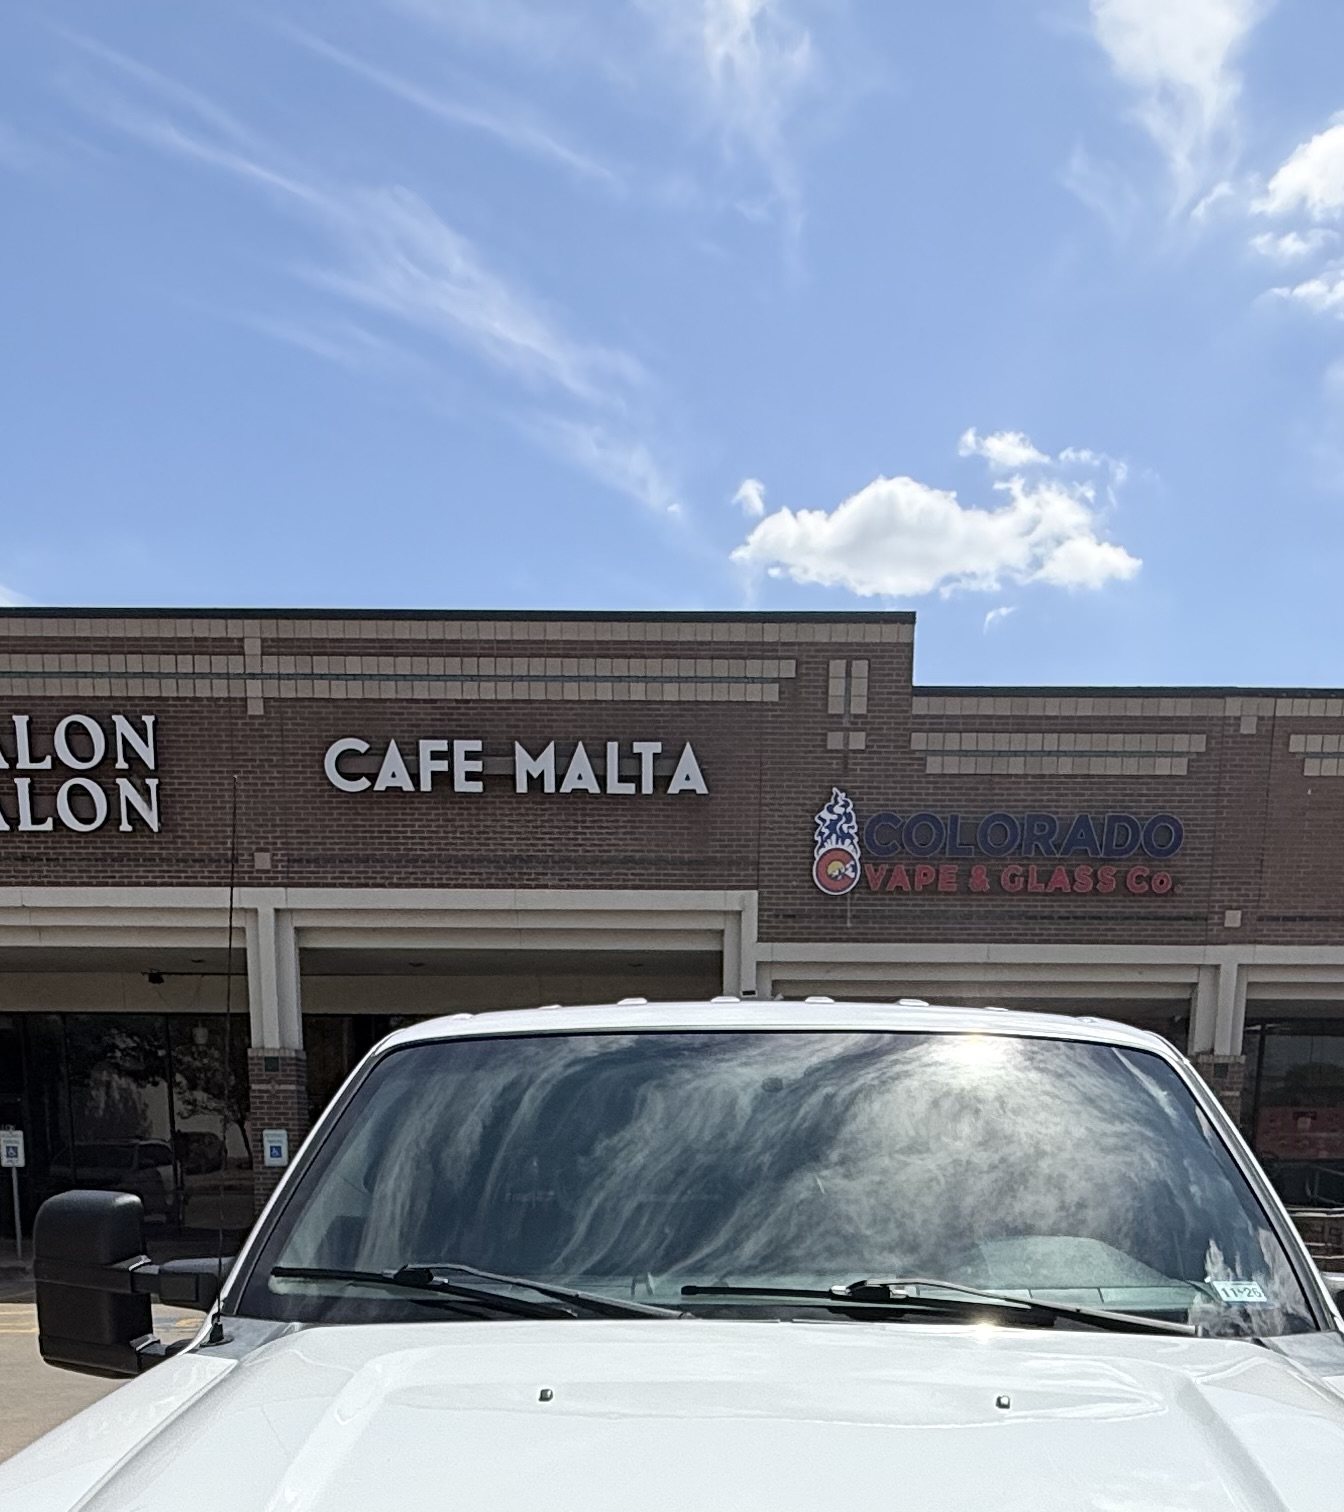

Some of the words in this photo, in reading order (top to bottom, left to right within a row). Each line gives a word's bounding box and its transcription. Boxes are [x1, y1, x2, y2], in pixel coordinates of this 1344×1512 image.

[324, 737, 484, 793] CAFE
[514, 740, 710, 795] MALTA
[864, 811, 1185, 858] COLORADO
[864, 864, 958, 892] VAPE
[969, 864, 991, 893] &
[1000, 864, 1117, 893] GLASS
[1126, 865, 1184, 894] Co.
